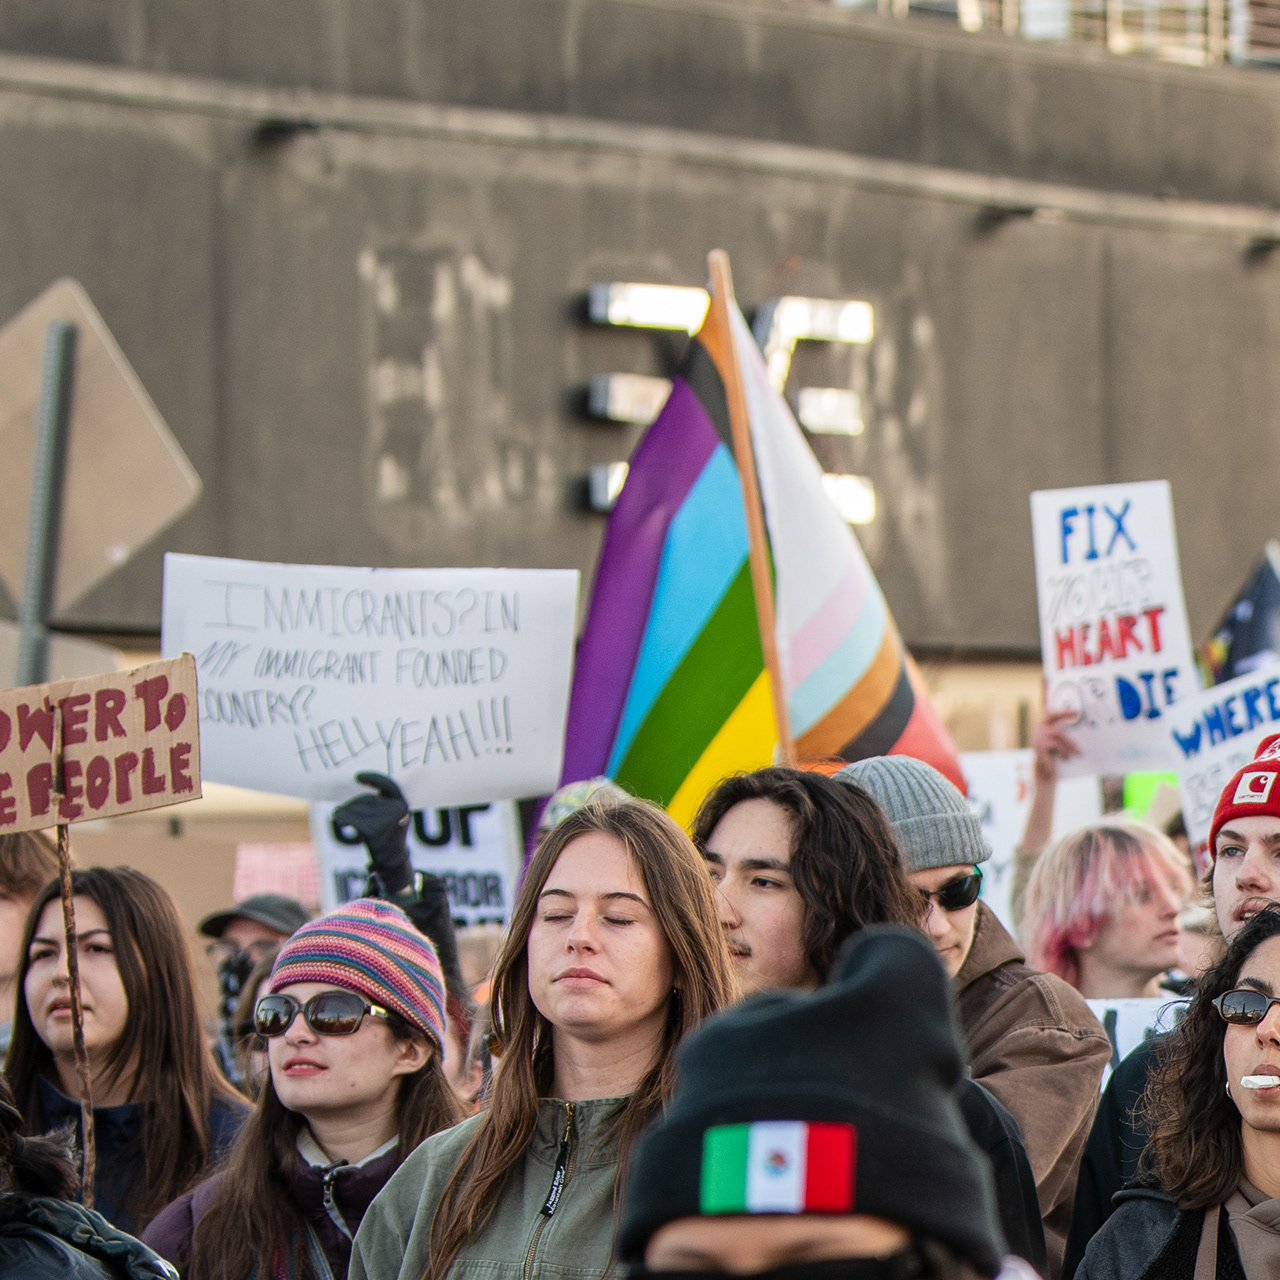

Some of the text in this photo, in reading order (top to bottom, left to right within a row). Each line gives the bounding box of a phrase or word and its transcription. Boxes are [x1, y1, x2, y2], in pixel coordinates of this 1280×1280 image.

[1059, 499, 1137, 565] FIX
[254, 646, 381, 684] IMMIGRANT
[396, 646, 508, 689] FOUNDED
[1054, 604, 1165, 670] HEART
[26, 742, 194, 822] PEOPLE
